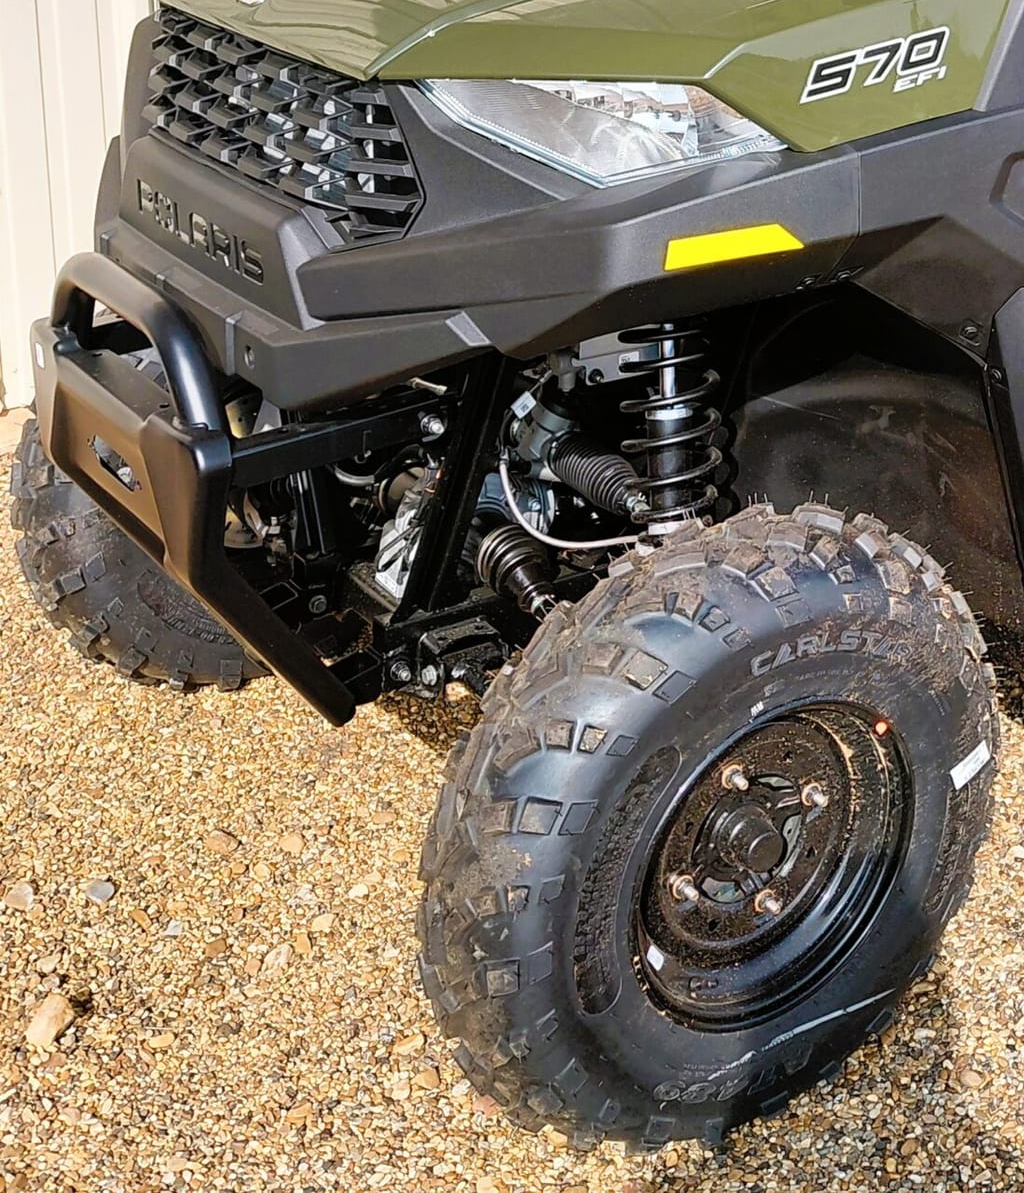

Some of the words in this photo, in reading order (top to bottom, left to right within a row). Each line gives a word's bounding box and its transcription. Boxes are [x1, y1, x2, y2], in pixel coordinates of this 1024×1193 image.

[799, 25, 950, 105] 570
[892, 65, 948, 93] EFI
[136, 178, 264, 287] POLARIS
